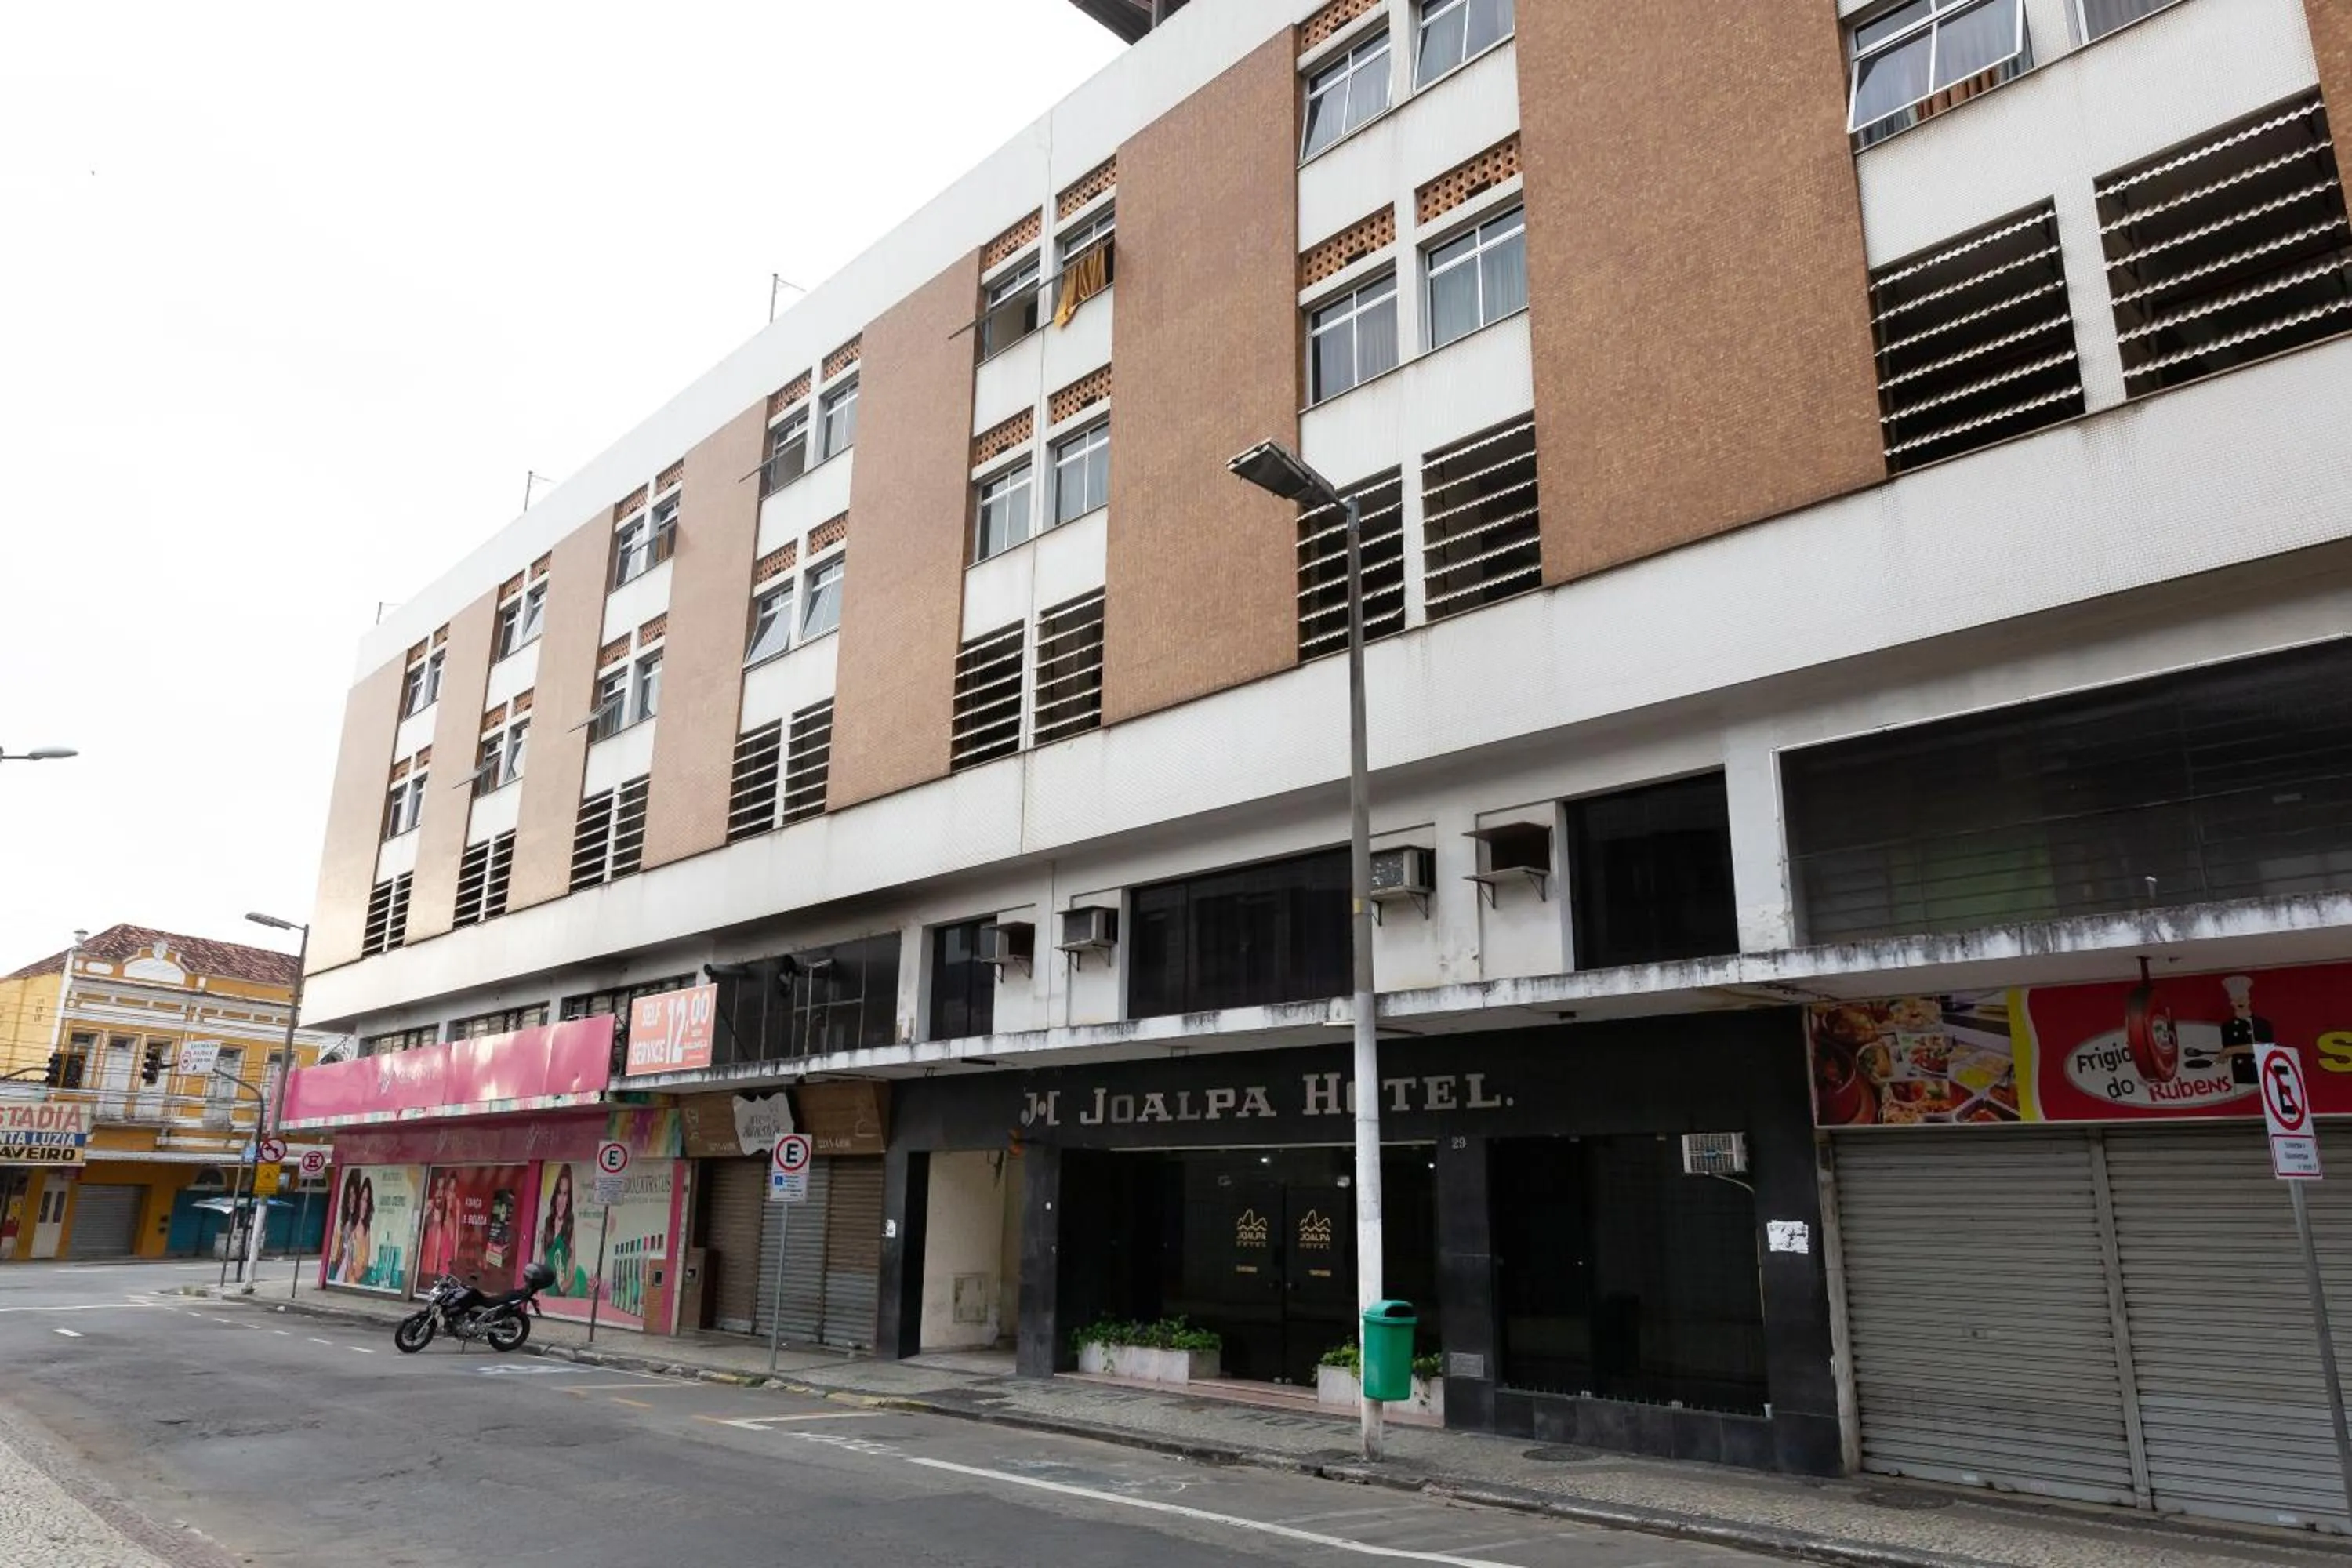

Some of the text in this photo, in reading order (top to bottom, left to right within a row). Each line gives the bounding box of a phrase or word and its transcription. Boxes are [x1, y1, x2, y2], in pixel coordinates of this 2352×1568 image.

[2107, 1076, 2135, 1099] do
[1080, 1086, 1277, 1125] JOALPA
[32, 1132, 76, 1146] LUZIA
[1452, 1138, 1466, 1149] 29
[0, 1146, 76, 1161] AVEIRO
[608, 1150, 619, 1166] E
[786, 1143, 799, 1163] E
[1300, 1233, 1330, 1242] JOALPA
